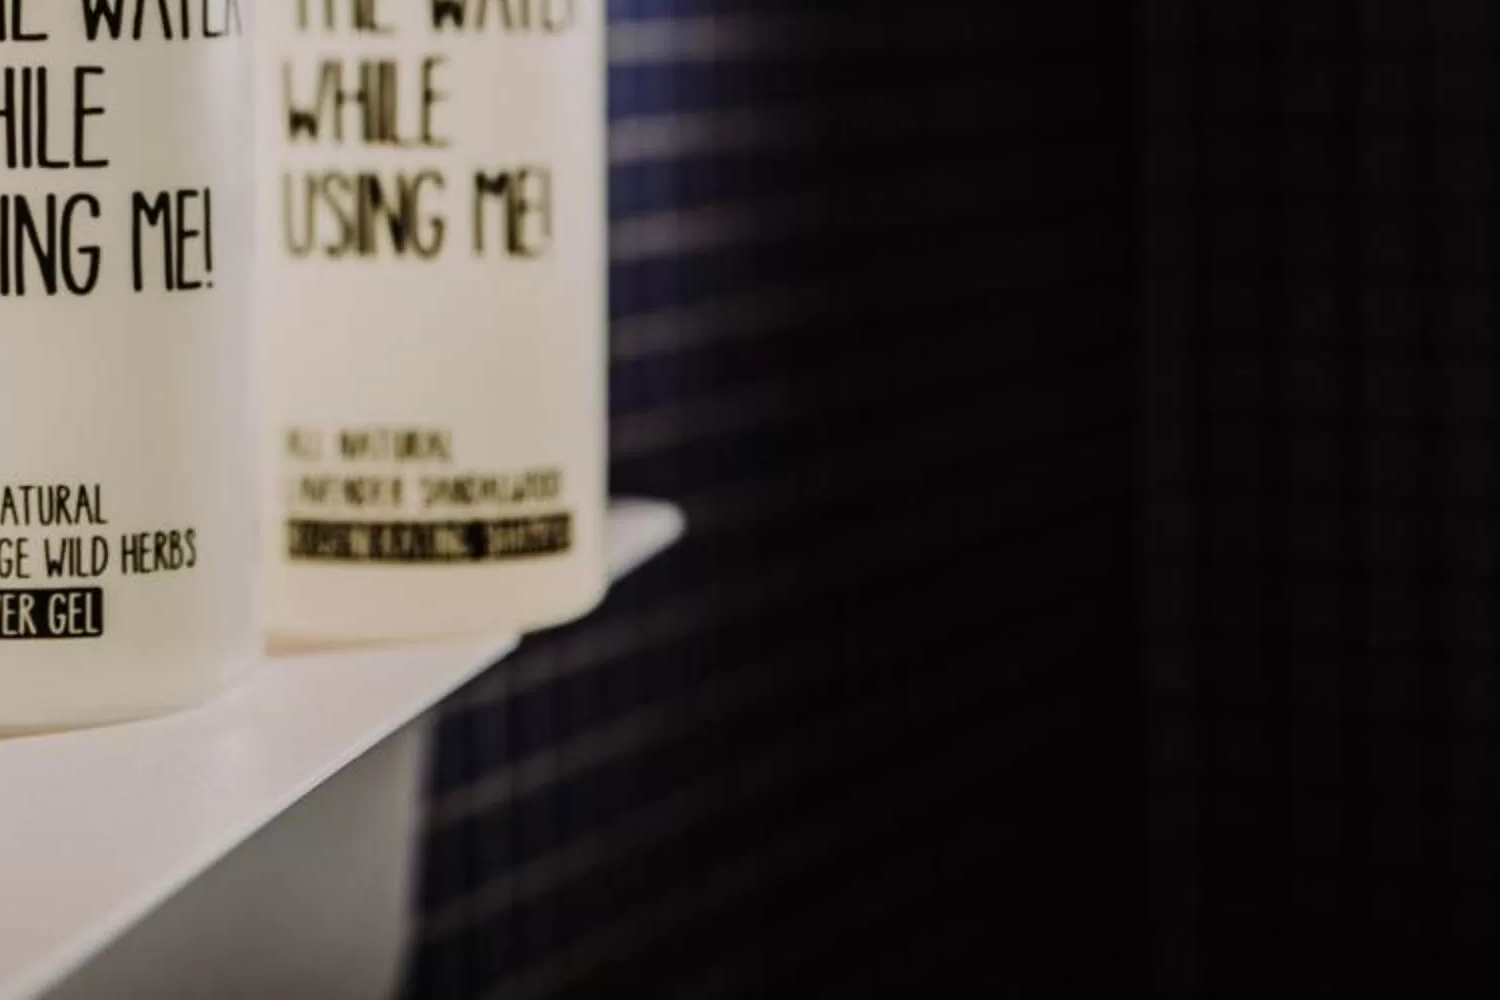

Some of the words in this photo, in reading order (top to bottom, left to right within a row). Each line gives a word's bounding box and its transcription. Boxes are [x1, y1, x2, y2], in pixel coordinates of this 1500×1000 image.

[283, 56, 451, 149] WHILE
[131, 186, 213, 292] ME!
[283, 168, 447, 259] USING
[43, 534, 110, 578] WILD
[120, 527, 198, 575] HERBS
[47, 591, 100, 636] GEL
